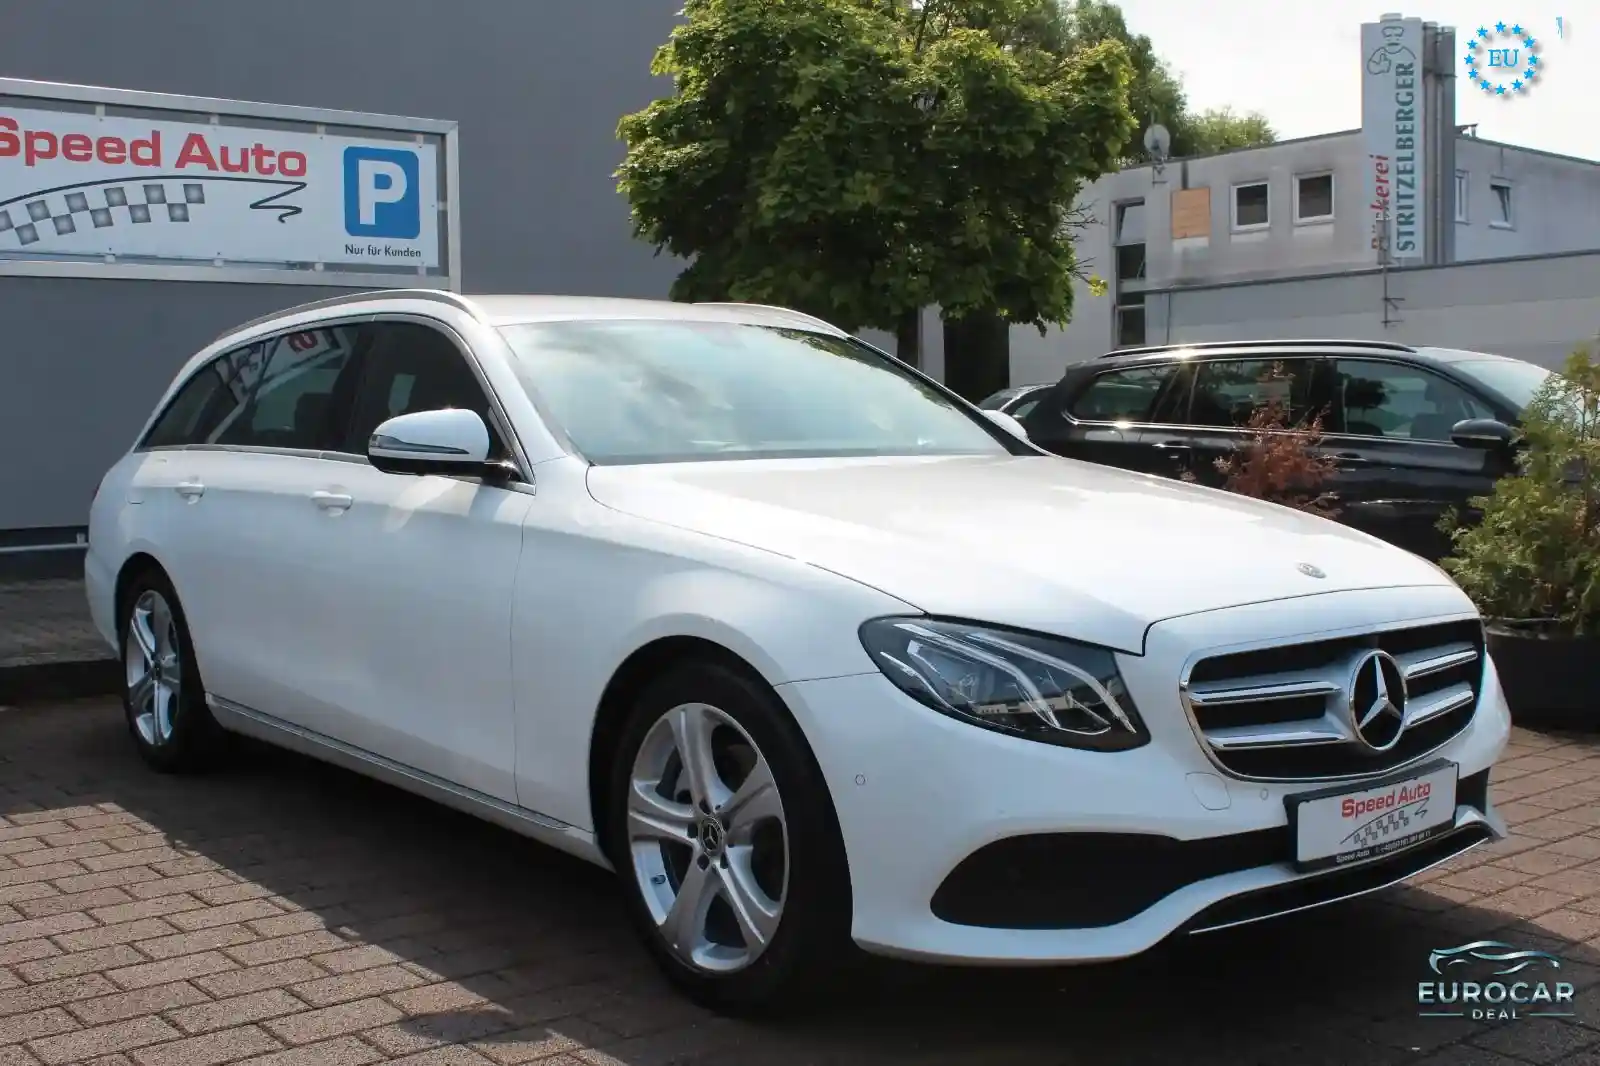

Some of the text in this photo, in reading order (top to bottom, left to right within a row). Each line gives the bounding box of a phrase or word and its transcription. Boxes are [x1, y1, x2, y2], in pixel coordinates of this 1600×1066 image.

[174, 133, 308, 177] Auto
[1395, 62, 1416, 251] STRITZELBERGER
[357, 159, 408, 225] P
[345, 243, 422, 258] Nur für Kunden
[1341, 782, 1431, 819] Speed Auto
[1336, 852, 1356, 863] Speed
